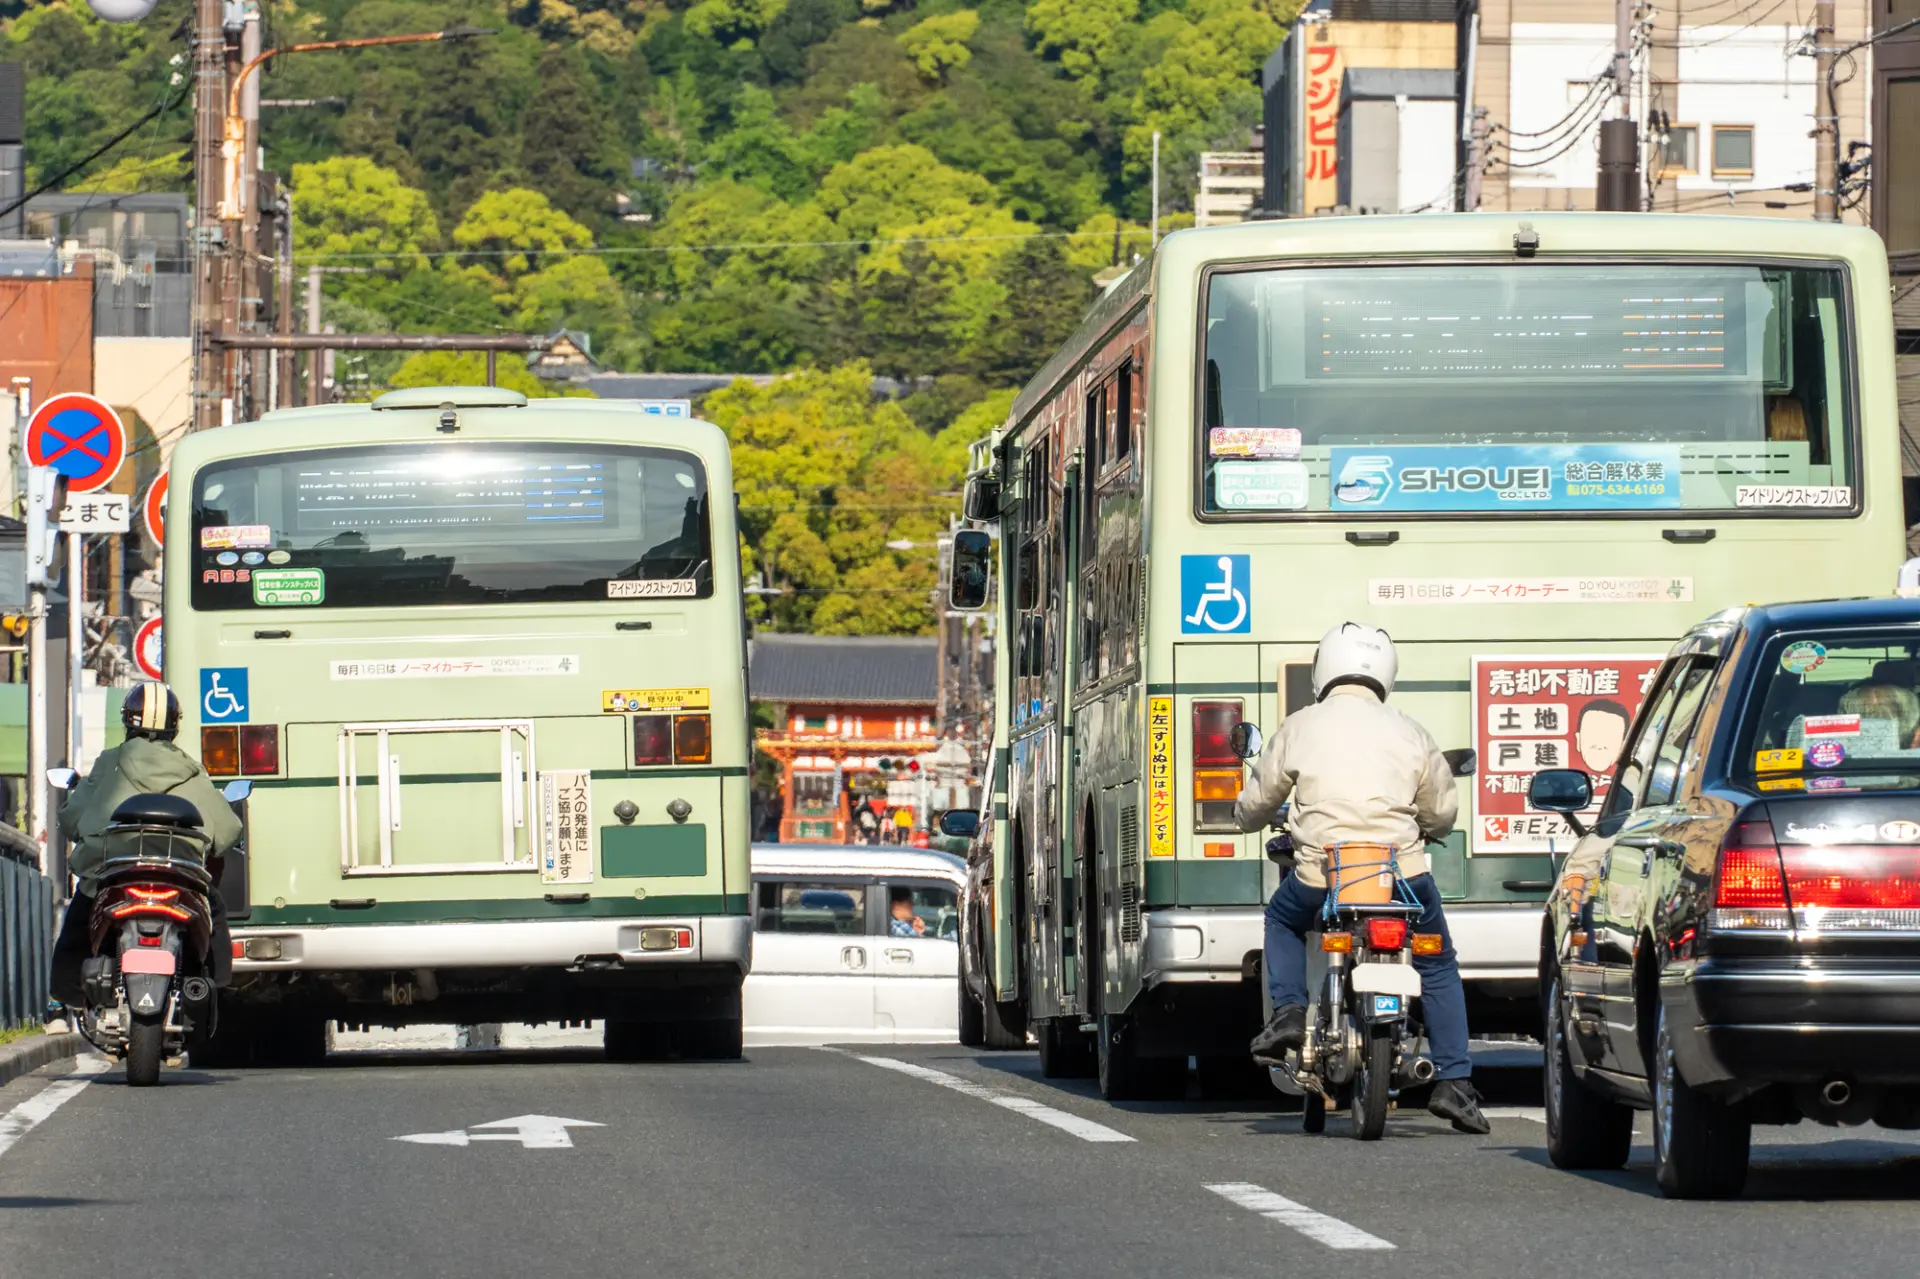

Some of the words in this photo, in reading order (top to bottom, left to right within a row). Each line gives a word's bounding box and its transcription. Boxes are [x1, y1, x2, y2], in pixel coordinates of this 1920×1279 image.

[1305, 46, 1339, 180] フジビル
[1400, 467, 1550, 491] SHOUEI
[1565, 462, 1664, 480] 総合解体業
[1739, 488, 1849, 504] アイドリングストップバス
[203, 569, 250, 583] ABS
[609, 581, 694, 595] アイドリングストップバス
[1378, 584, 1455, 599] 毎月16日は
[1460, 583, 1569, 597] ノーマイカーデー
[1489, 668, 1619, 696] 売却不動産
[1498, 707, 1558, 730] 土地
[1498, 743, 1558, 767] 戸建
[1761, 752, 1782, 762] JR
[1786, 751, 1797, 760] 2
[573, 774, 588, 852] バスの発進に
[558, 788, 572, 879] ご協力願います
